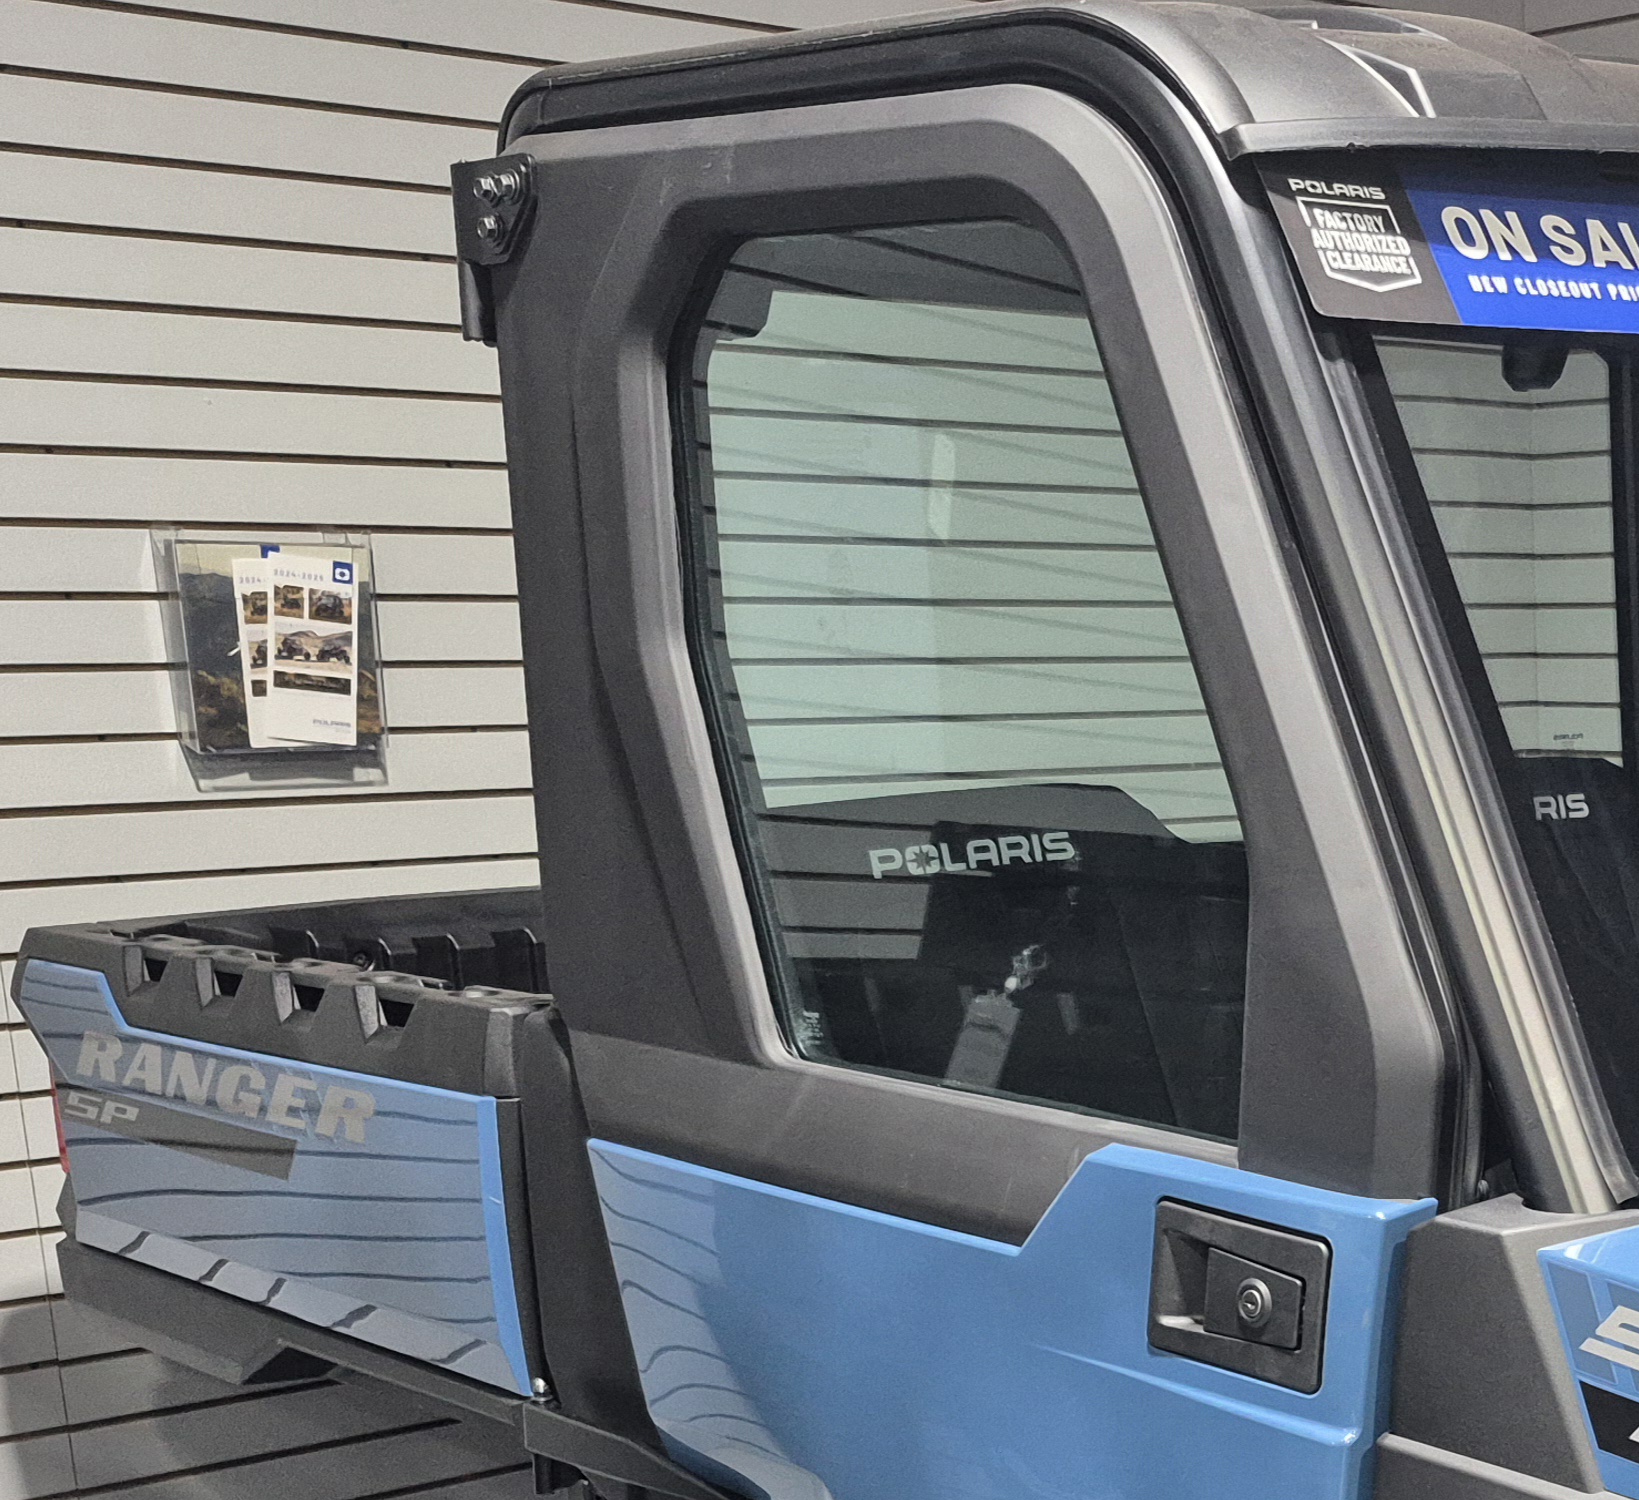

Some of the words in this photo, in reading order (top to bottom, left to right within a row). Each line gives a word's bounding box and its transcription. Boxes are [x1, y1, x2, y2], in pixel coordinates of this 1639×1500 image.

[1288, 178, 1386, 200] POLARIS
[1312, 207, 1386, 233] FACTORY
[1310, 228, 1411, 256] AUTHORIZED
[1441, 206, 1538, 262] ON
[1325, 250, 1412, 275] CLEARANCE
[1468, 274, 1508, 294] NEW
[1515, 277, 1602, 301] CLOSEOUT
[1532, 793, 1590, 820] RIS
[868, 831, 1076, 879] POLARIS
[76, 1030, 377, 1144] RANGER
[64, 1091, 140, 1124] SP
